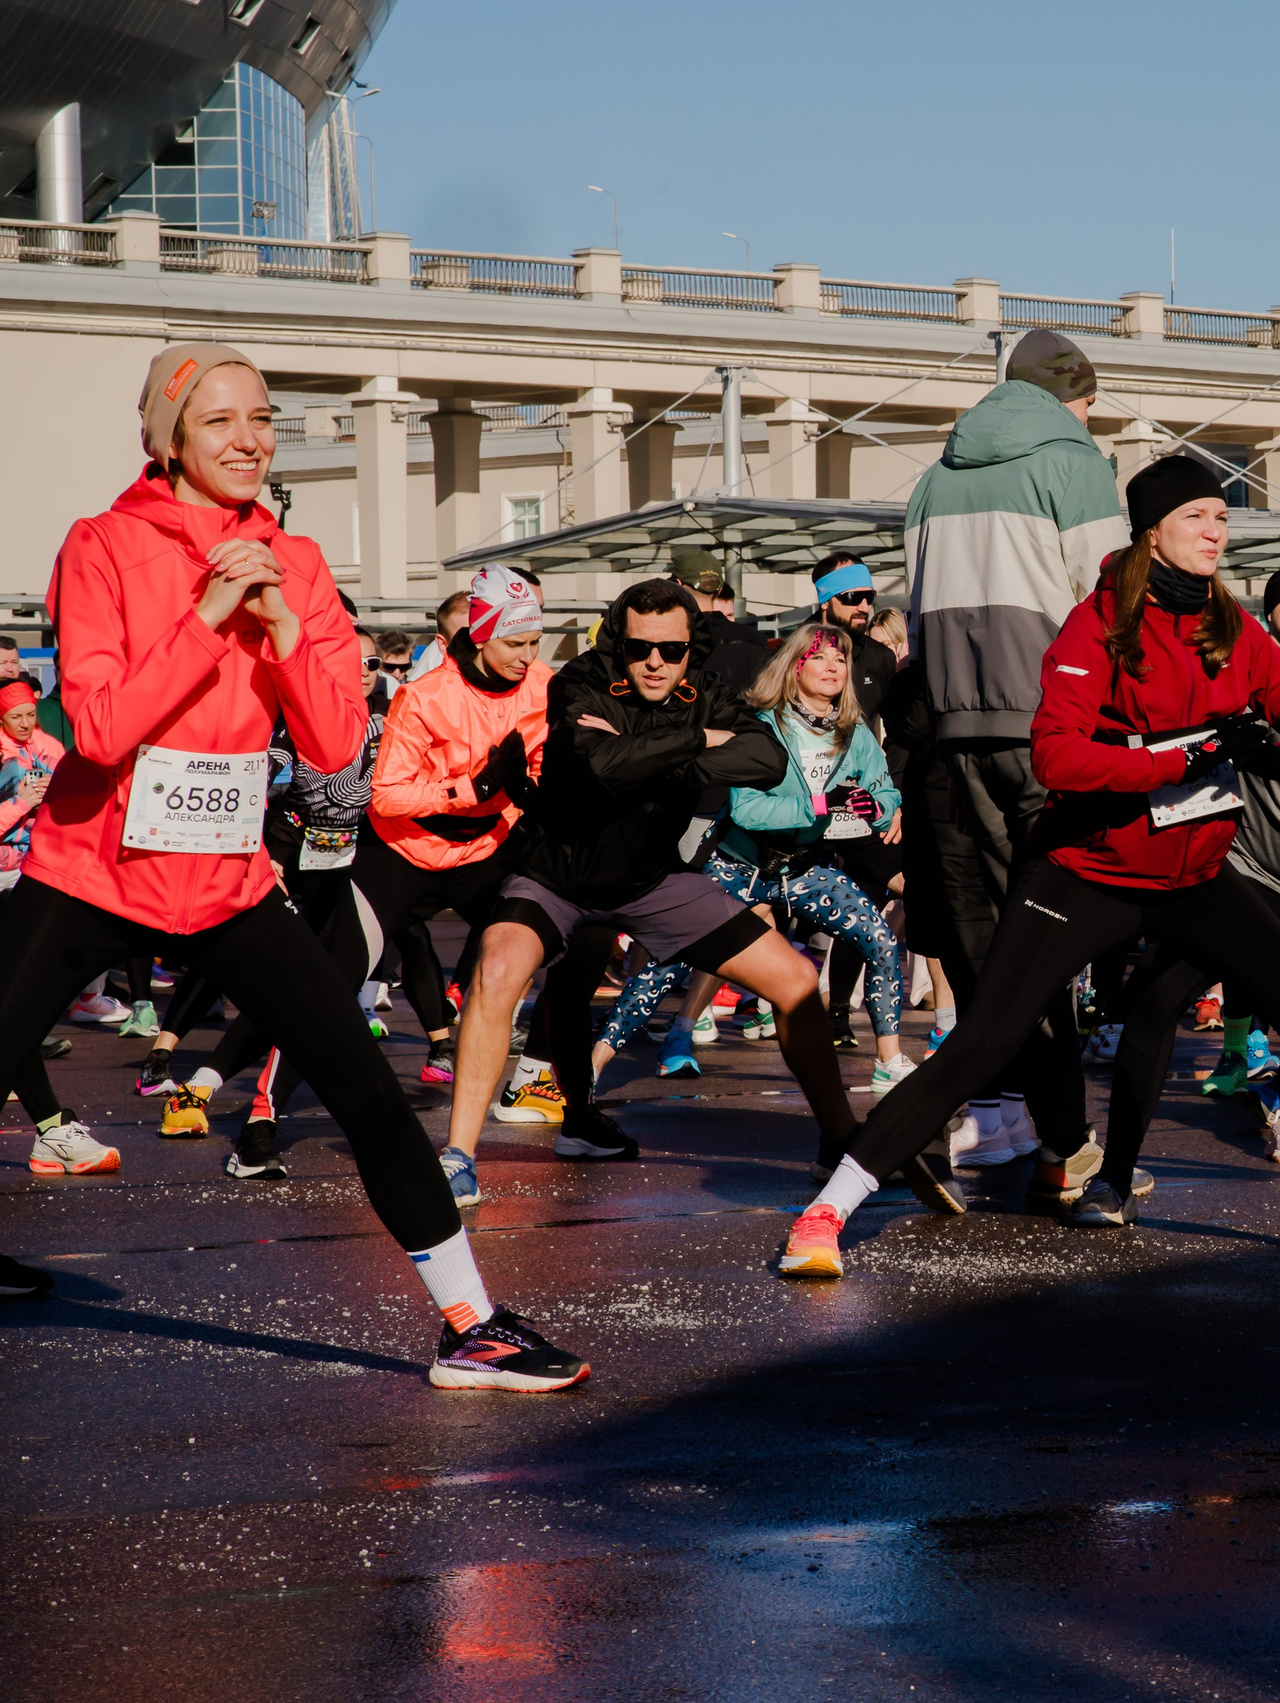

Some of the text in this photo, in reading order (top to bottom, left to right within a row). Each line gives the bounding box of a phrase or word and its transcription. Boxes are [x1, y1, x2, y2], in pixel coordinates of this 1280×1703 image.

[184, 768, 231, 776] ПОЛУМАРАФОН
[186, 760, 231, 771] АРЕНА
[810, 764, 831, 778] 614
[166, 785, 240, 813] 6588
[164, 811, 236, 824] АЛЕКСАНДРА
